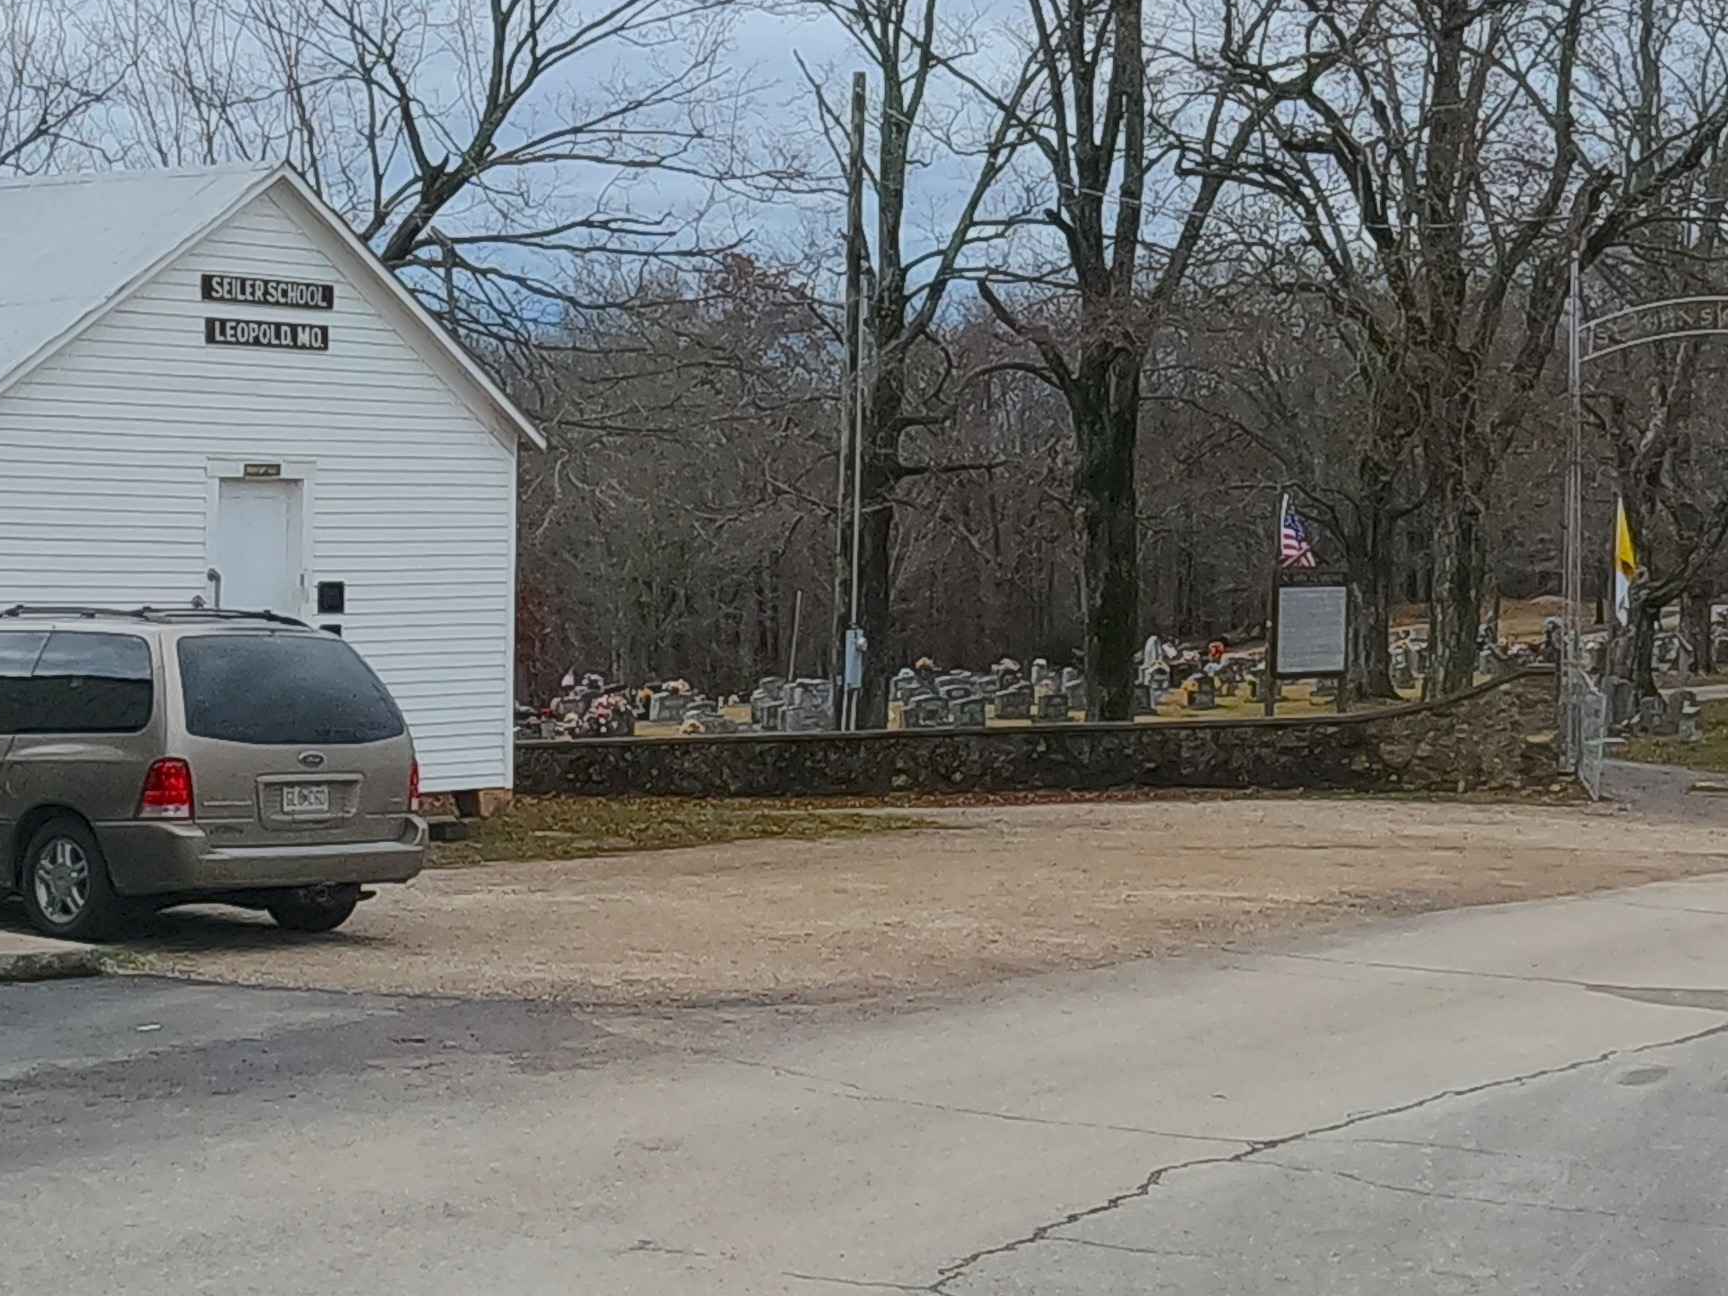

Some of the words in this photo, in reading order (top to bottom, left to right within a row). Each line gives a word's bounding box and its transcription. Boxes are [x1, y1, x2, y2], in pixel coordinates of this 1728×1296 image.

[211, 276, 264, 302] SEILER
[267, 282, 328, 307] SCHOOL
[297, 326, 324, 348] MO.
